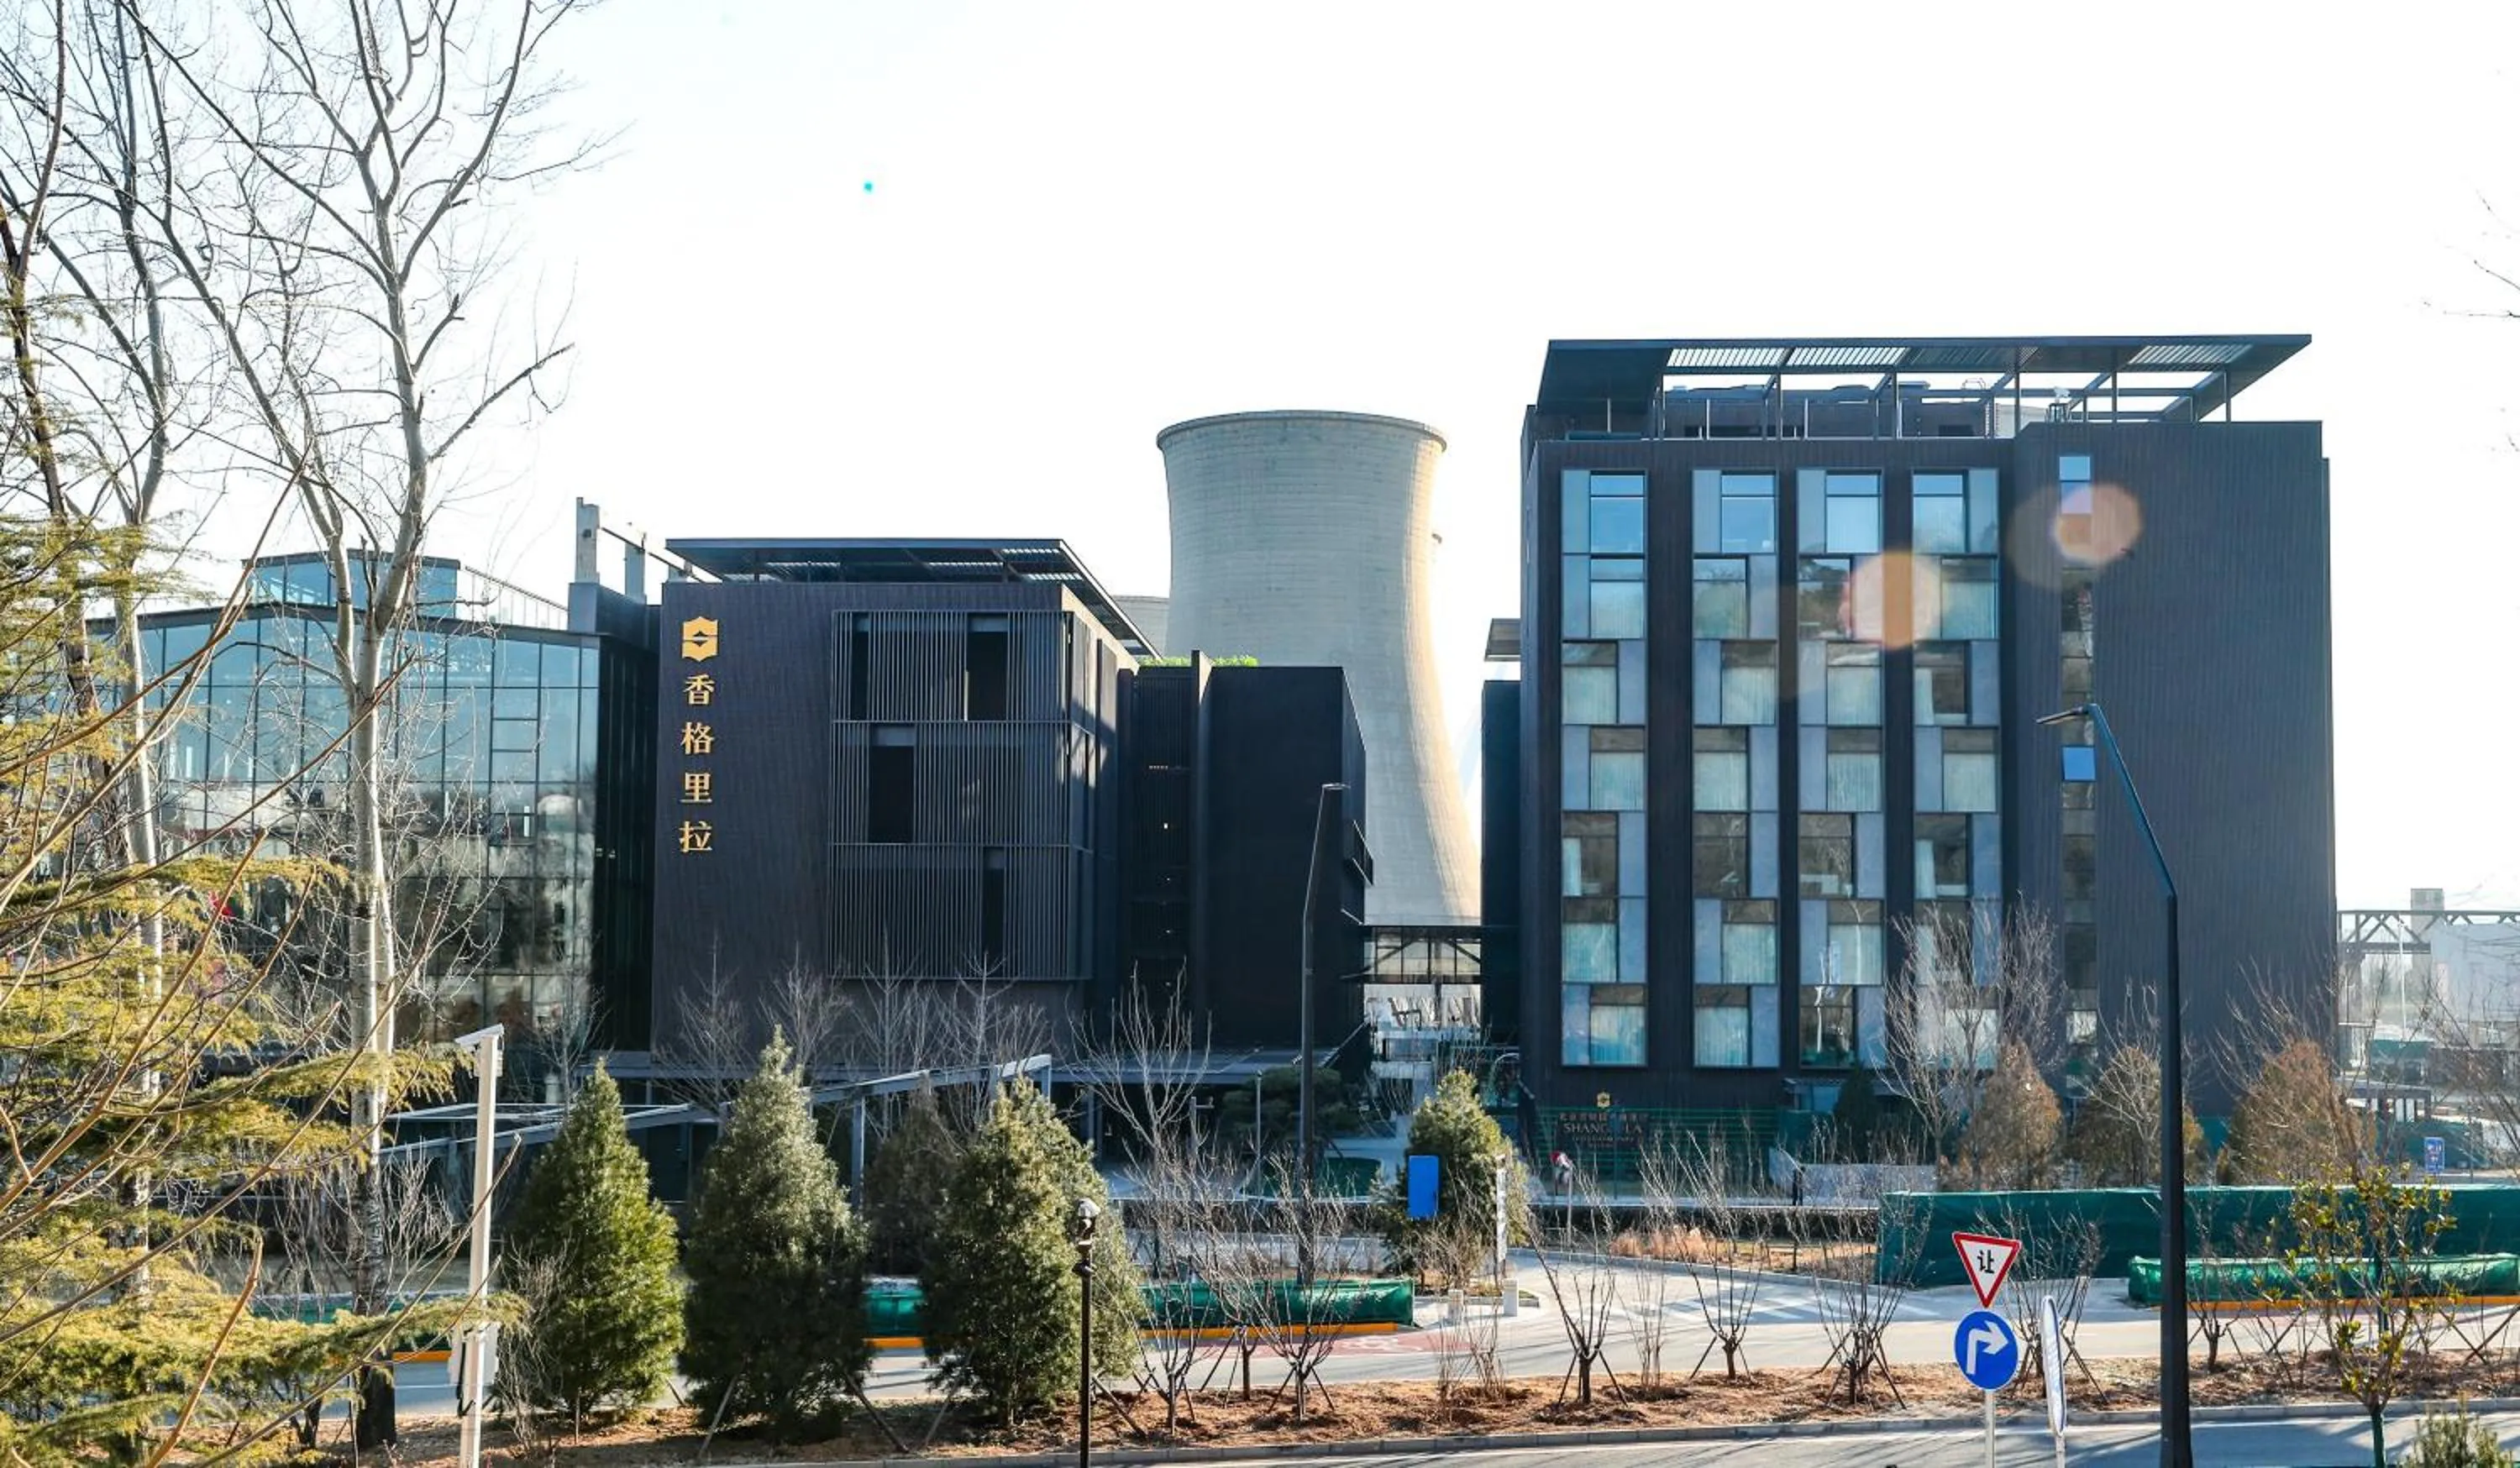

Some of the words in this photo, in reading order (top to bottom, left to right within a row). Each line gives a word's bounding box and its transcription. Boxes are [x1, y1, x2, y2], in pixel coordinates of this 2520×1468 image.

[680, 674, 715, 853] 香格里拉
[1563, 1123, 1642, 1134] SHANGLA
[1977, 1249, 1995, 1274] 让
